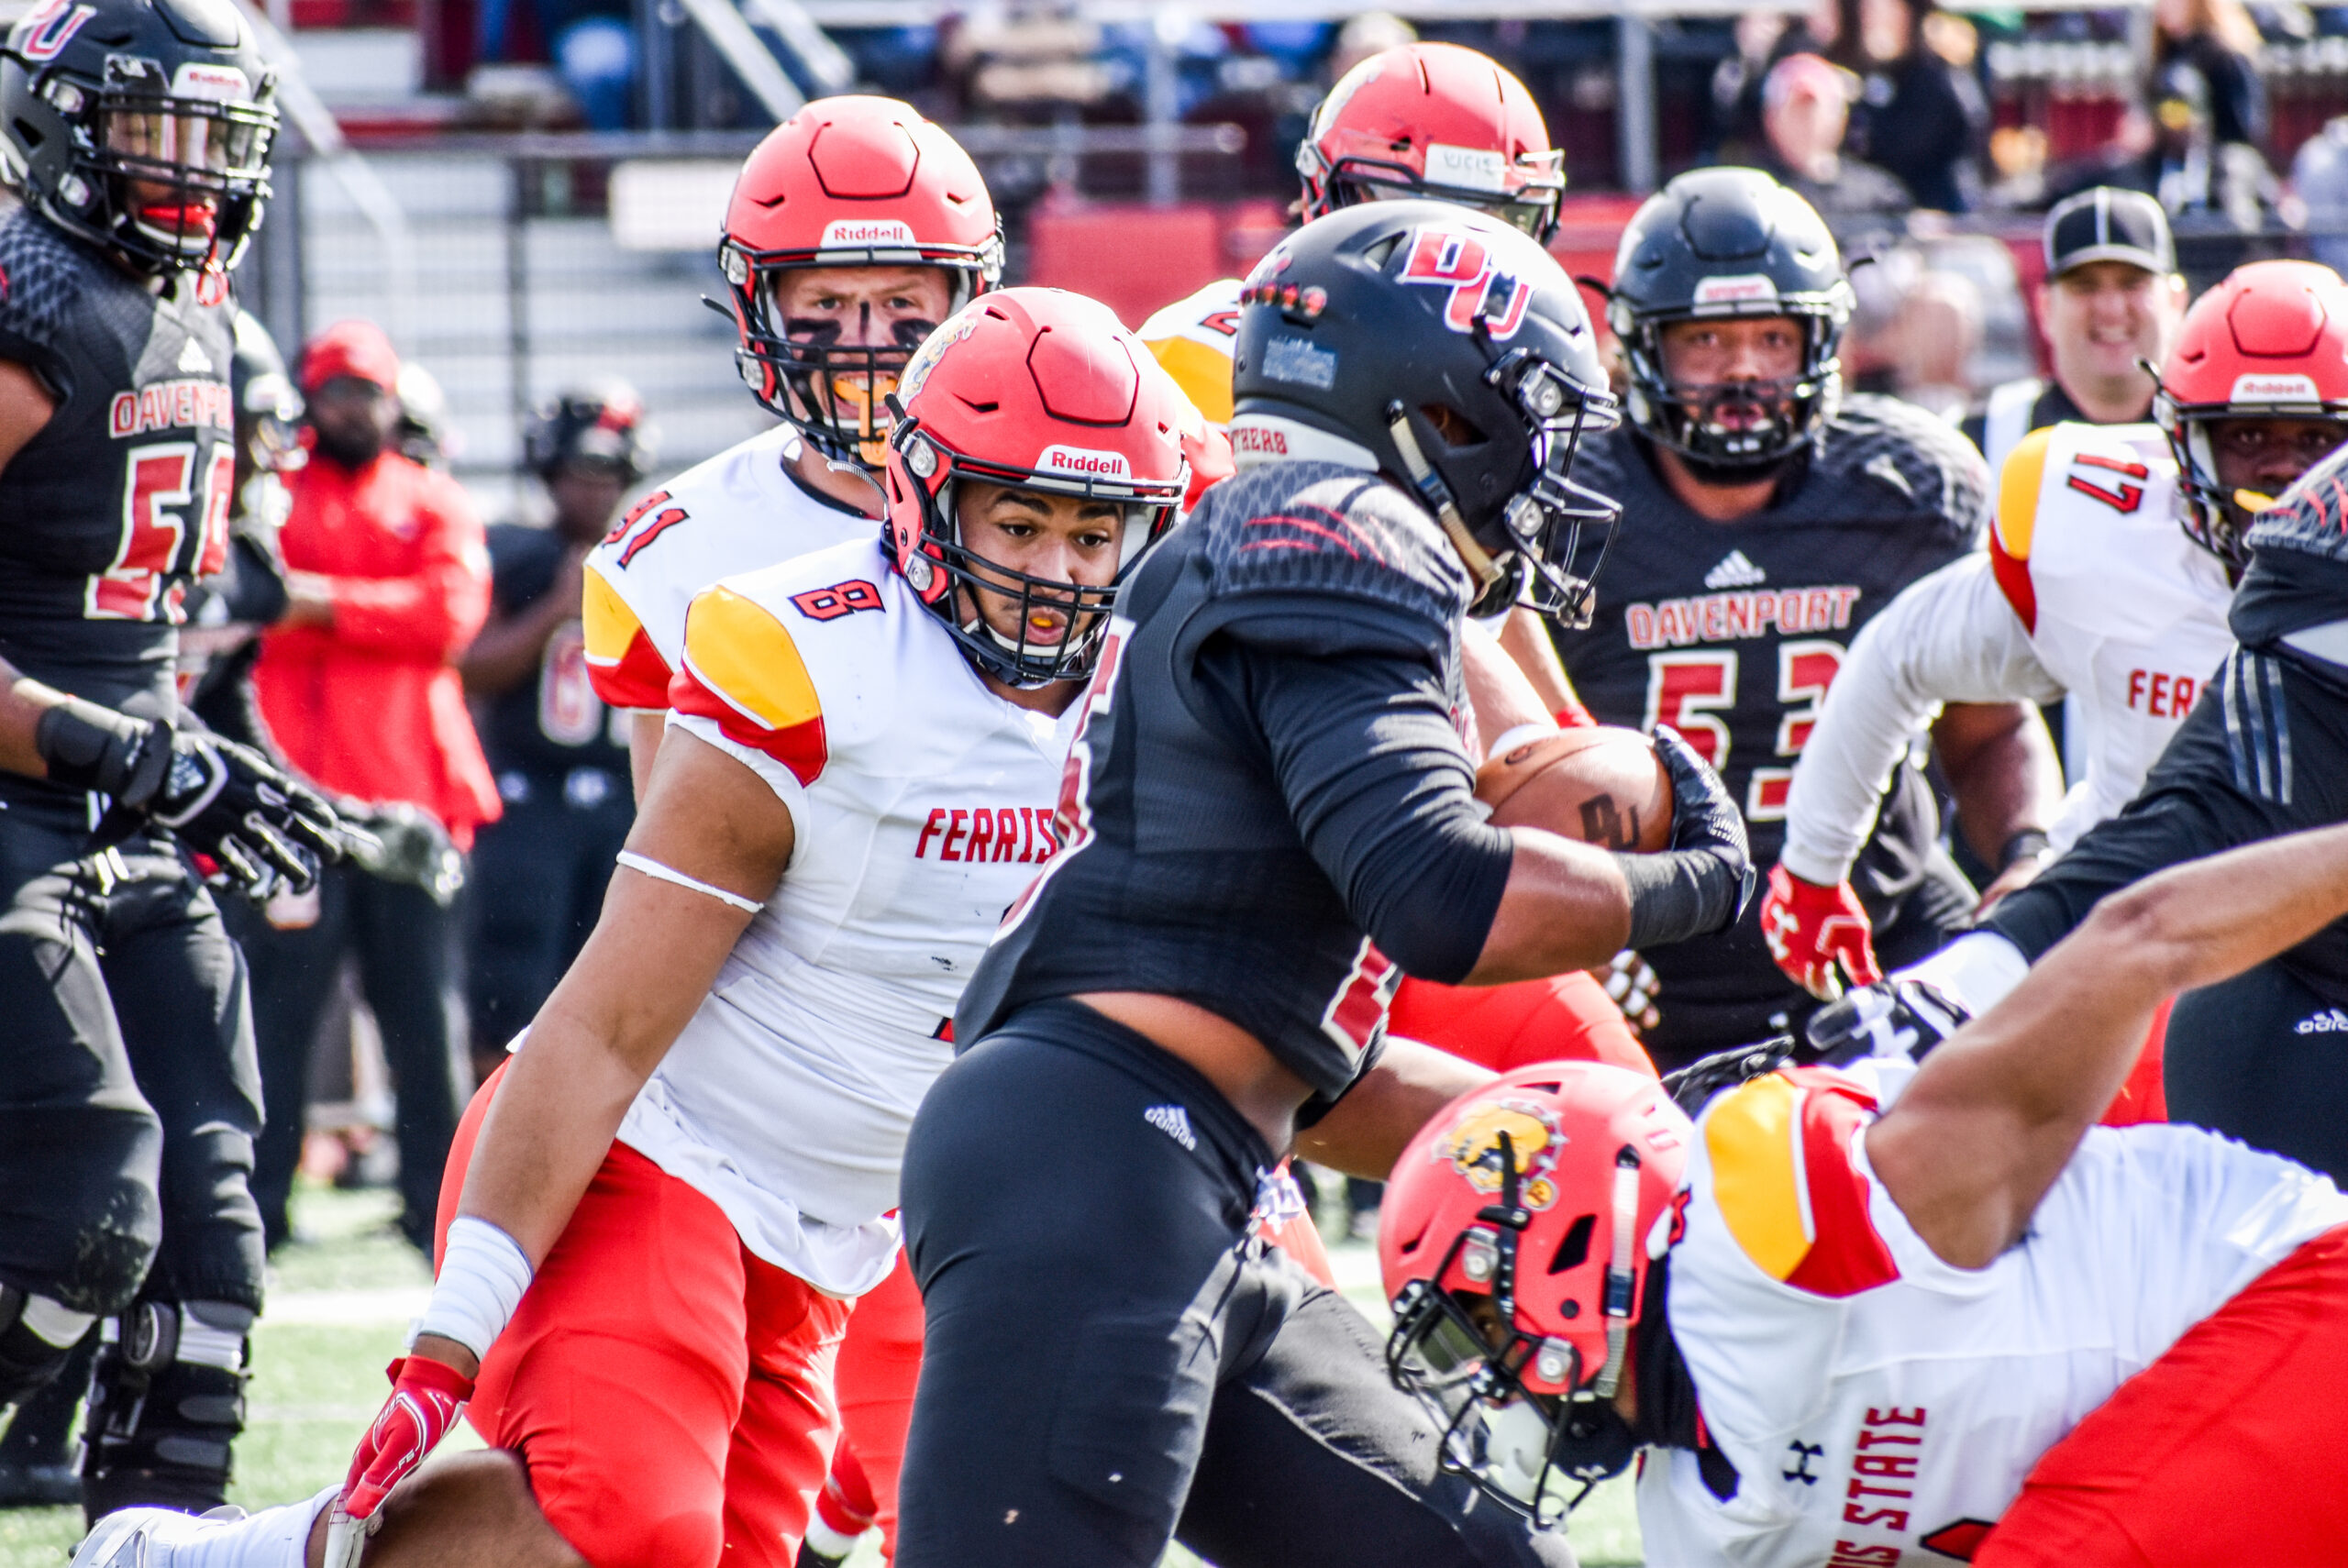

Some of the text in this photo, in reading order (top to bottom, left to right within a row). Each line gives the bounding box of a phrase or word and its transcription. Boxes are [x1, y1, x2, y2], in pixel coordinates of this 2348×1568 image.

[834, 226, 903, 241] Riddell
[1394, 225, 1538, 343] DU
[1051, 451, 1123, 474] Riddell
[787, 579, 887, 623] 8
[1625, 584, 1862, 650] DAVENPORT
[914, 807, 1058, 865] FERRIS
[1578, 793, 1640, 850] DU
[1843, 1408, 1926, 1531] STATE
